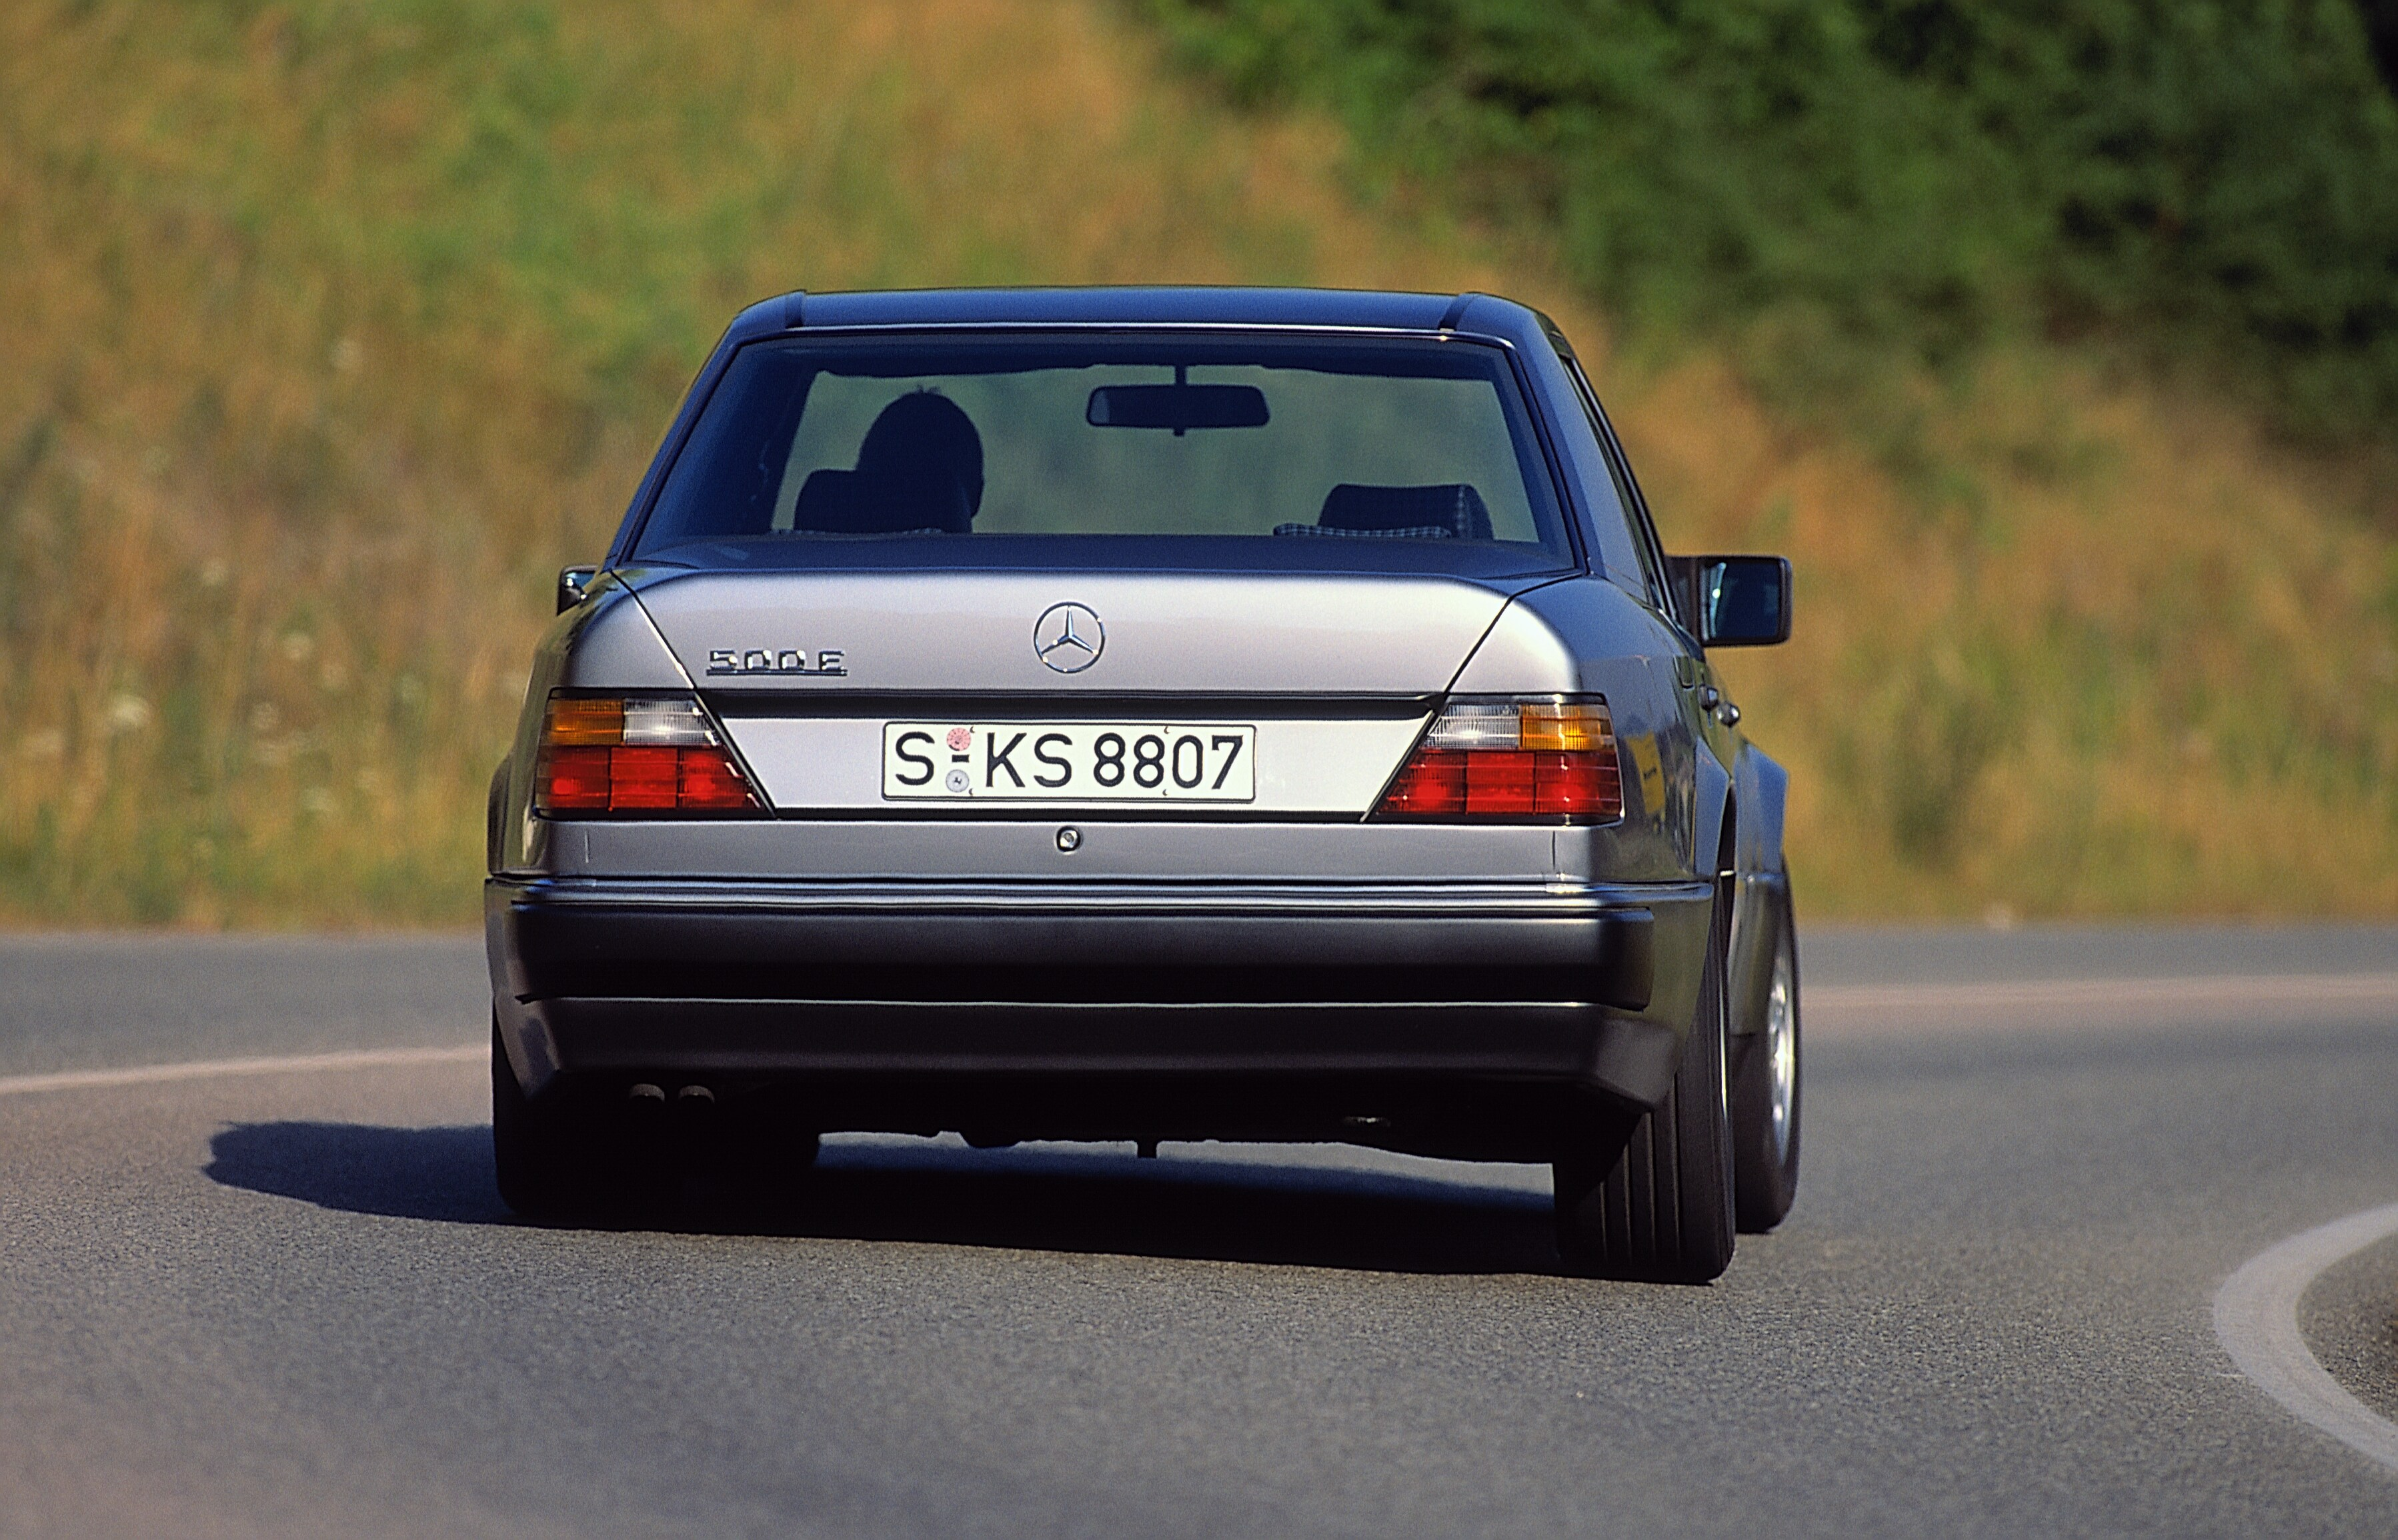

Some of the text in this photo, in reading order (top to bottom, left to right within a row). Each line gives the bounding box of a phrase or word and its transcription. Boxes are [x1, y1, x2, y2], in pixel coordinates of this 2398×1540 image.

[710, 649, 845, 670] 500 E
[1093, 732, 1244, 789] 8807
